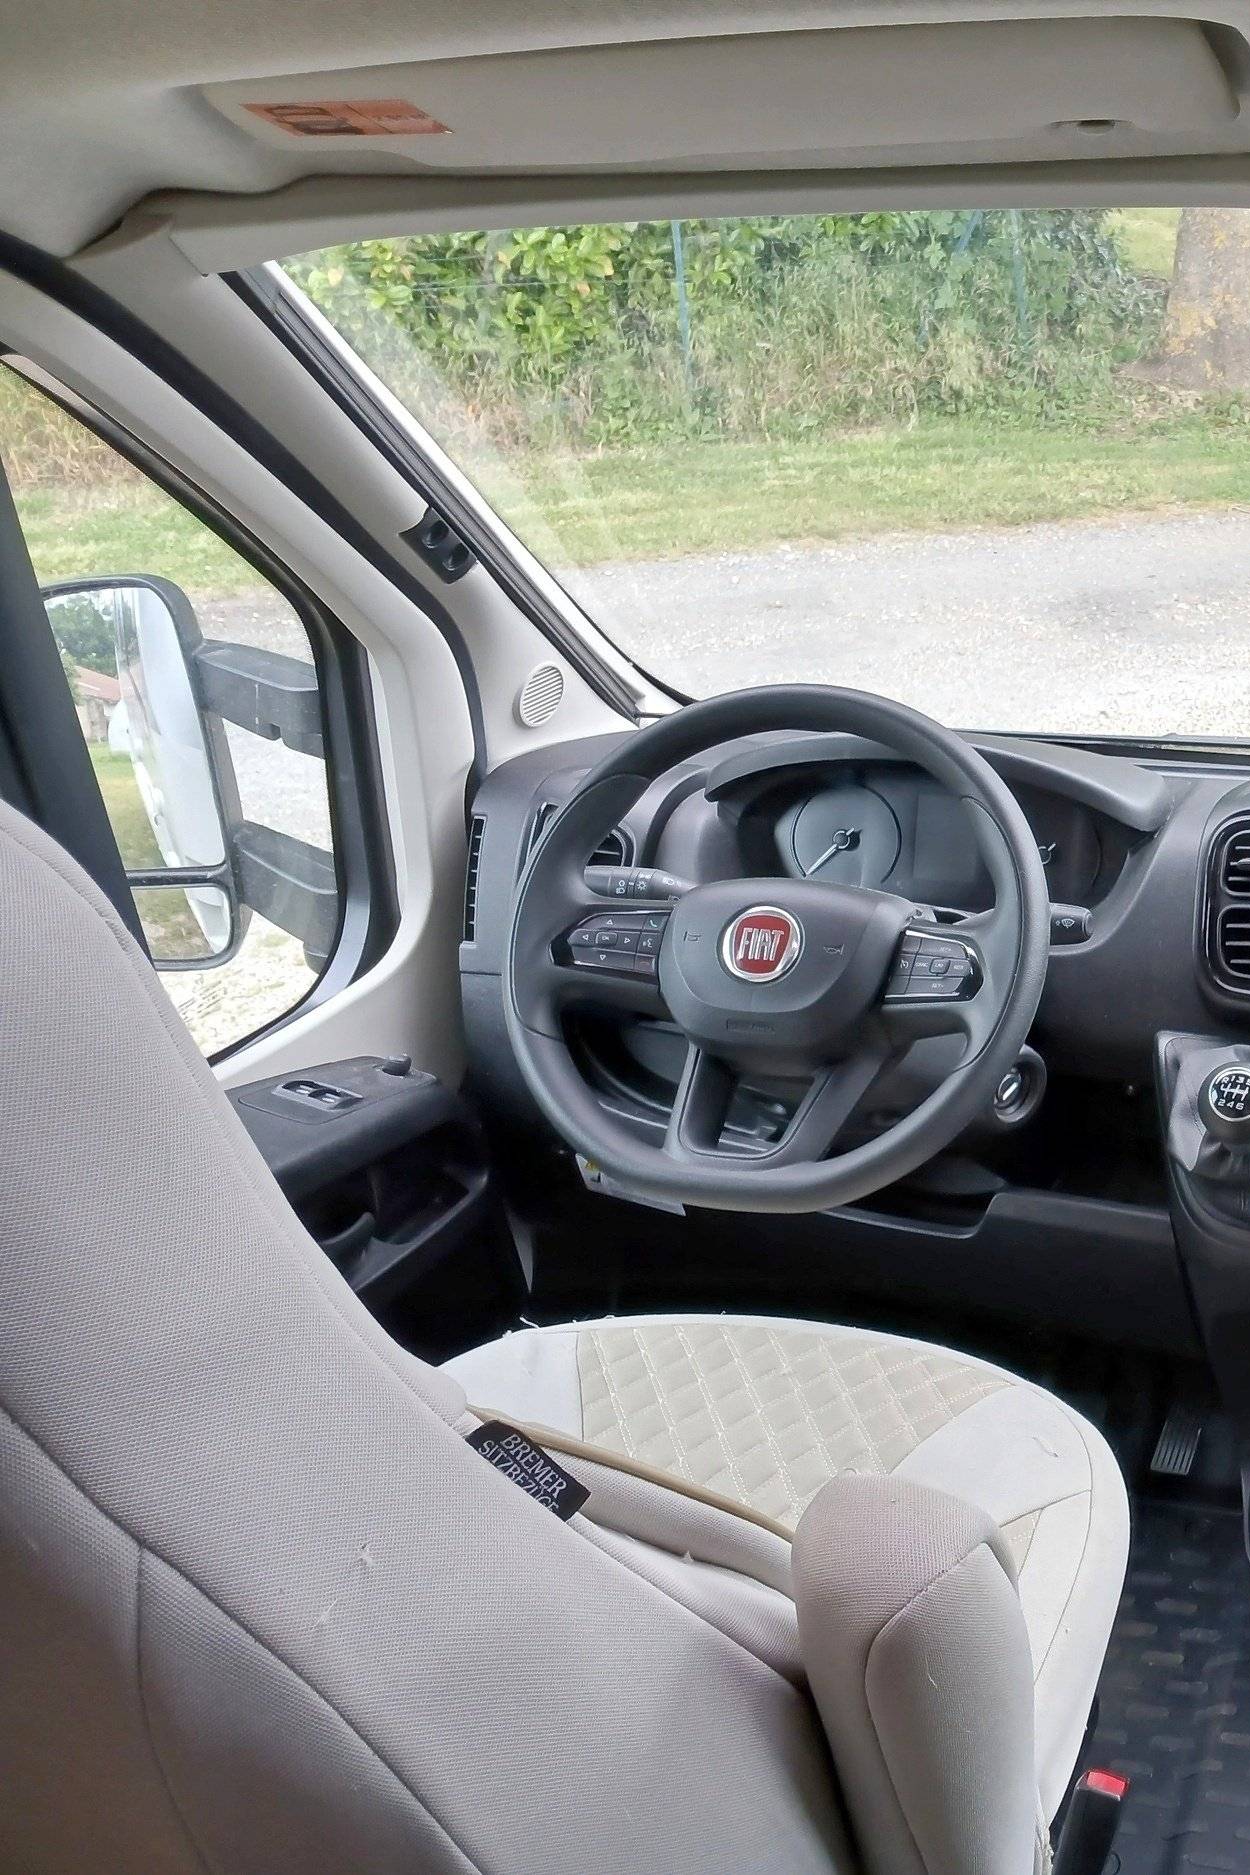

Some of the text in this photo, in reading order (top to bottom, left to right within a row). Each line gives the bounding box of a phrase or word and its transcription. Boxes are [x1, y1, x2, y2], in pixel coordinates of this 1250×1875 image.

[737, 927, 785, 961] FIAT
[1221, 1076, 1230, 1084] R
[1236, 1076, 1245, 1084] 3
[1217, 1099, 1245, 1111] 2 4 6
[500, 1433, 568, 1499] BREMER
